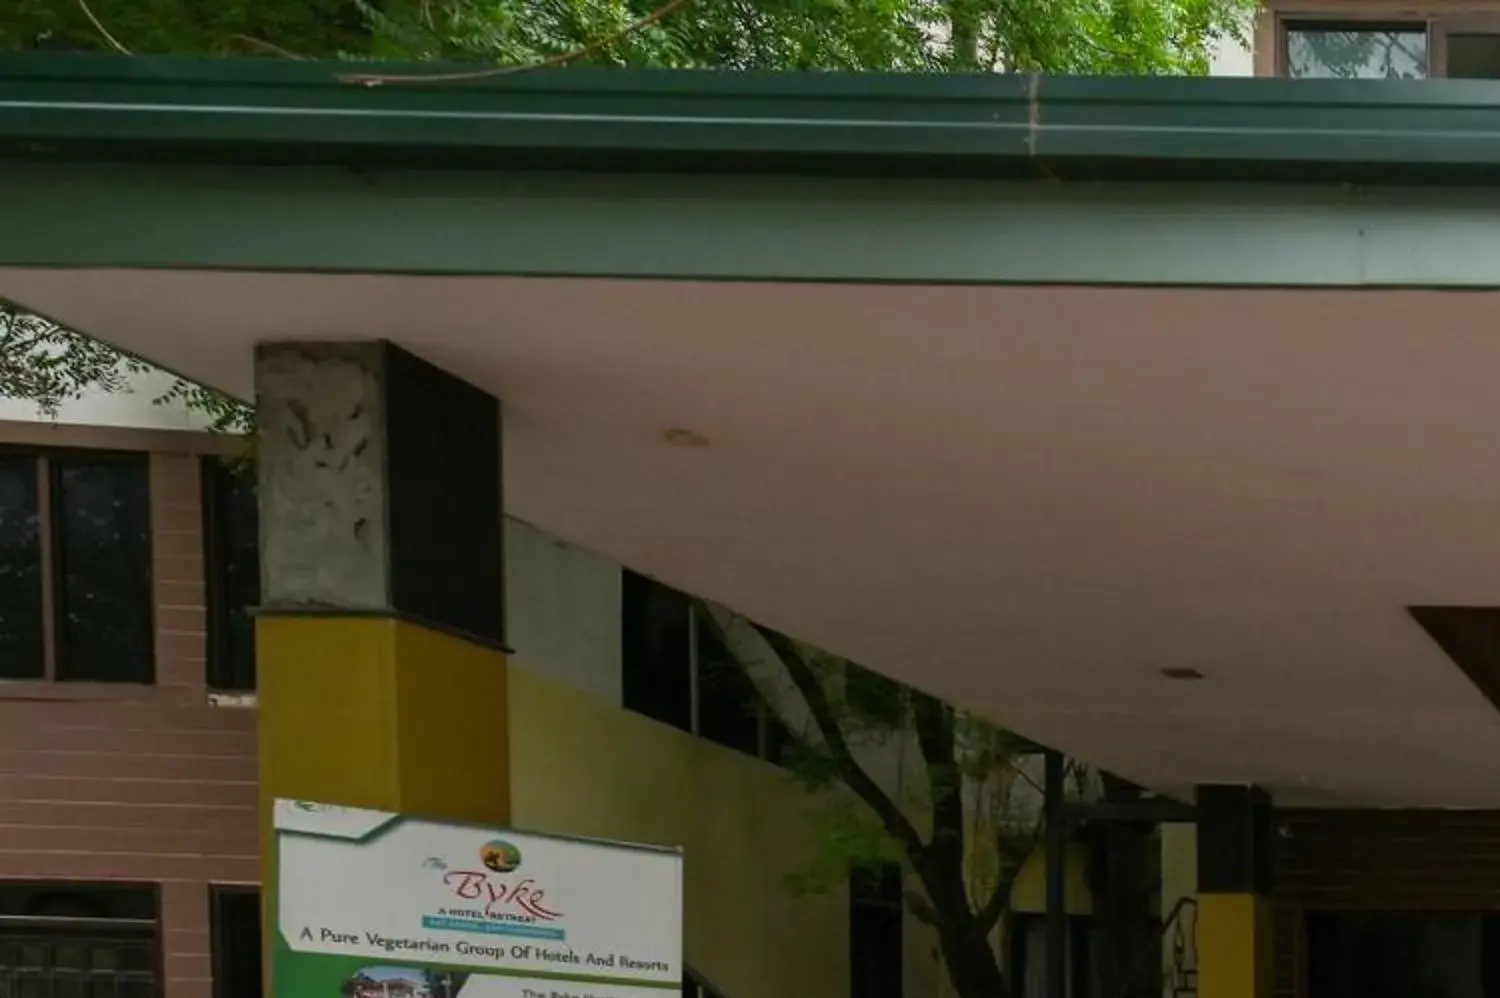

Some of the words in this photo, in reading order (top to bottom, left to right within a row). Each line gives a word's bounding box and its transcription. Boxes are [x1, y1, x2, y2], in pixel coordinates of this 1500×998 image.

[444, 871, 564, 920] Byke
[449, 909, 484, 919] HOTEL
[489, 911, 537, 924] RETREAT
[300, 927, 313, 941] A
[320, 928, 359, 945] Pure
[366, 932, 450, 953] Vegetarian
[455, 941, 504, 960] Group
[511, 945, 531, 959] Of
[536, 948, 580, 964] Hotels
[586, 952, 615, 967] And
[619, 956, 669, 972] Resorts
